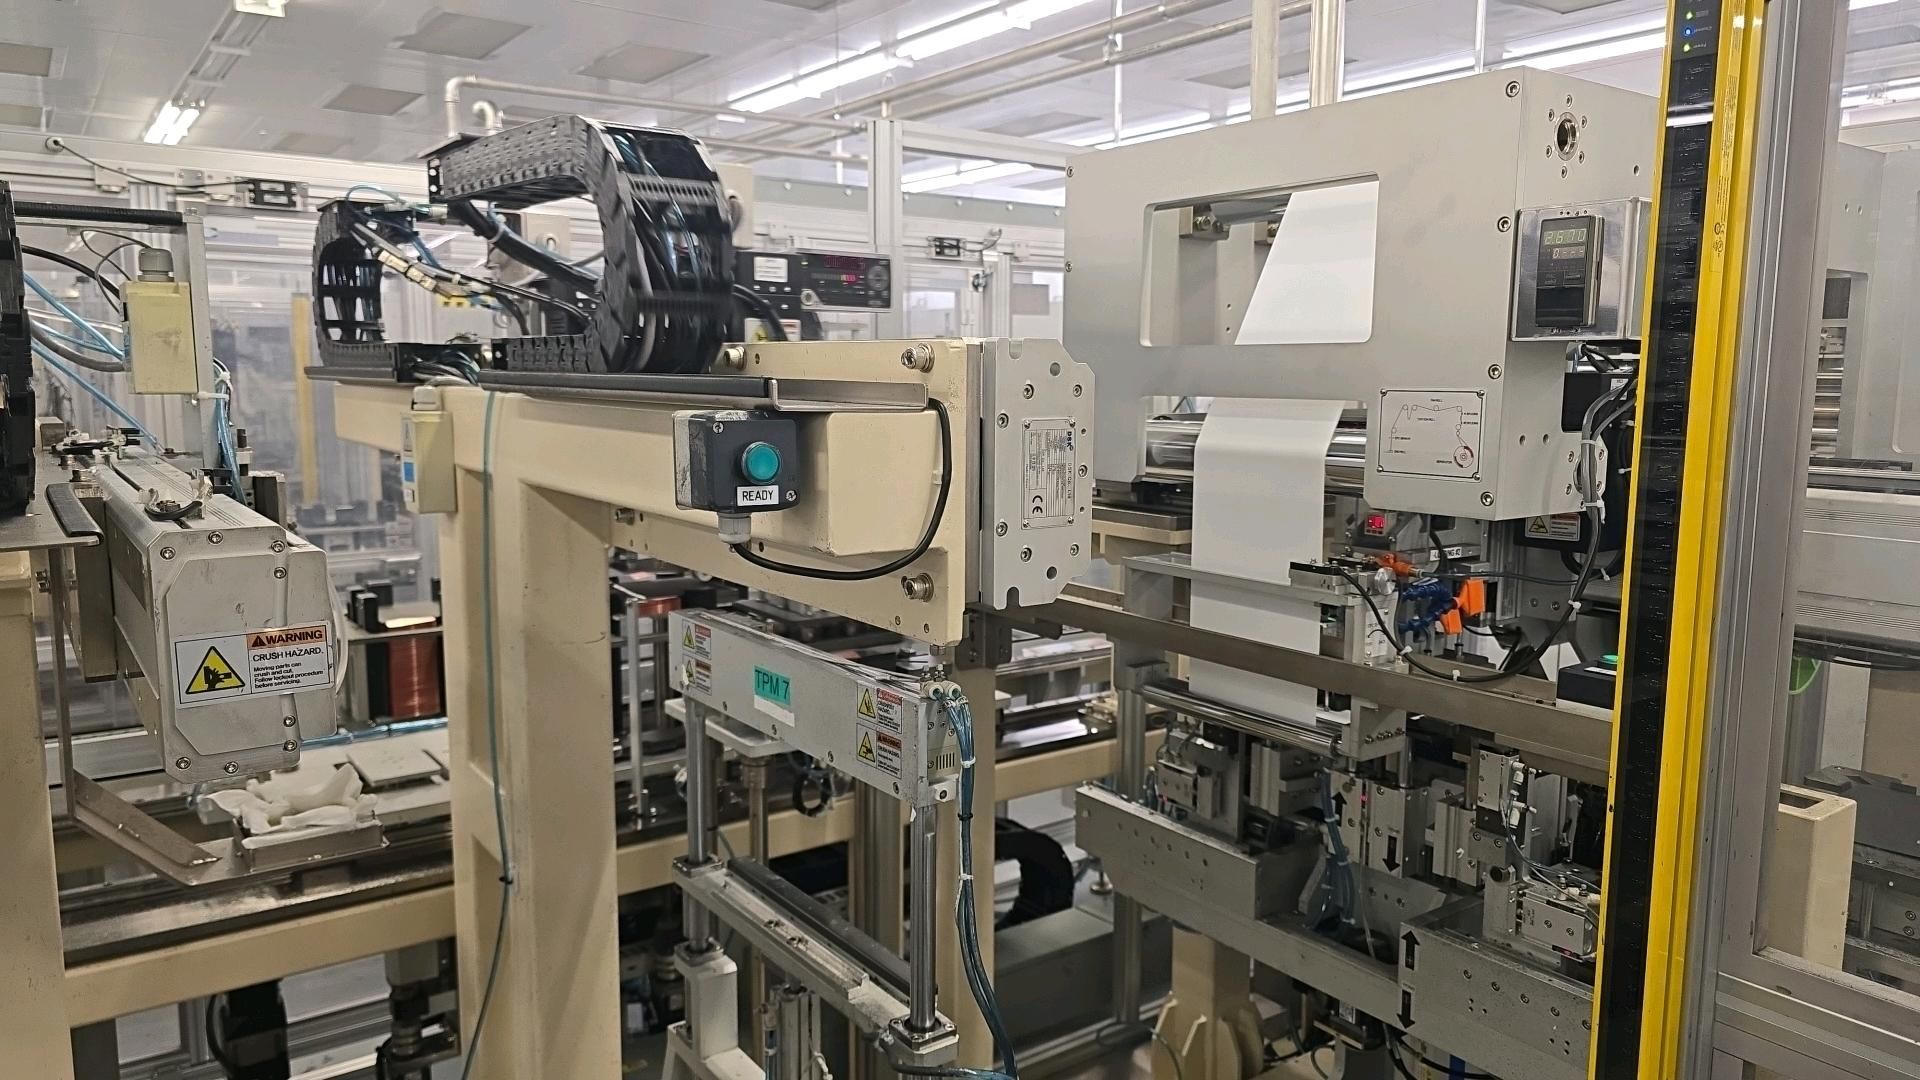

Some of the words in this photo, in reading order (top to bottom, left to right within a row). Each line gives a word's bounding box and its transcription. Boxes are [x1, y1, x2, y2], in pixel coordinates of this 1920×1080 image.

[742, 490, 773, 501] READY
[1032, 495, 1043, 514] CE
[266, 630, 323, 644] WARNING
[253, 651, 284, 662] CRUSH
[285, 647, 324, 658] HAZARD.
[254, 665, 275, 673] Moving
[273, 673, 294, 681] lockout
[295, 670, 324, 678] procedure
[755, 669, 779, 696] TPM
[783, 680, 790, 699] 7
